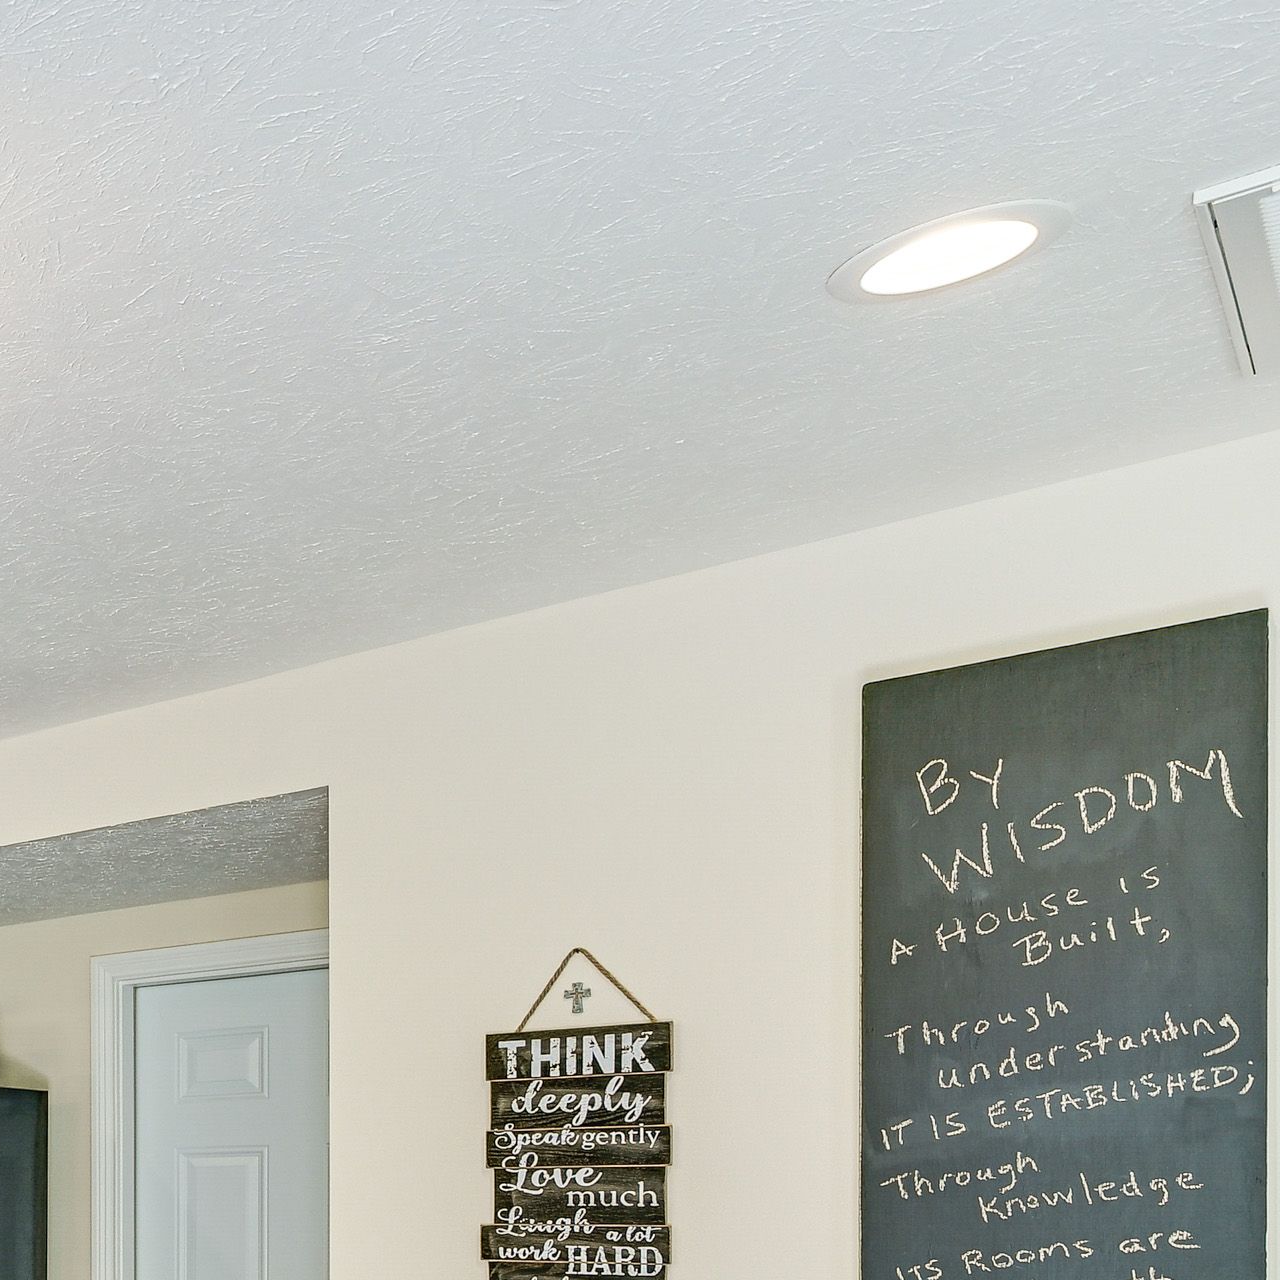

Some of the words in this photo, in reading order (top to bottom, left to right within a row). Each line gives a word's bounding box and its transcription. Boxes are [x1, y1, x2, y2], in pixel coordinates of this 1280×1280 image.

[915, 758, 1004, 816] BY
[921, 749, 1244, 894] WISDOM
[890, 938, 917, 965] A
[884, 992, 1070, 1055] Through
[497, 1031, 656, 1080] THINK
[938, 1011, 1241, 1089] understanding
[511, 1075, 653, 1127] deeply
[493, 1123, 580, 1155] Speak
[582, 1123, 661, 1150] gently
[880, 1118, 914, 1151] IT
[930, 1112, 967, 1141] IS
[499, 1151, 603, 1196] Love
[566, 1181, 660, 1207] much
[880, 1152, 1040, 1200] Through
[496, 1206, 596, 1242] Laugh
[606, 1230, 623, 1242] a
[625, 1225, 662, 1243] lot
[1119, 1228, 1202, 1254] are
[498, 1238, 562, 1261] work
[565, 1245, 664, 1277] HARD
